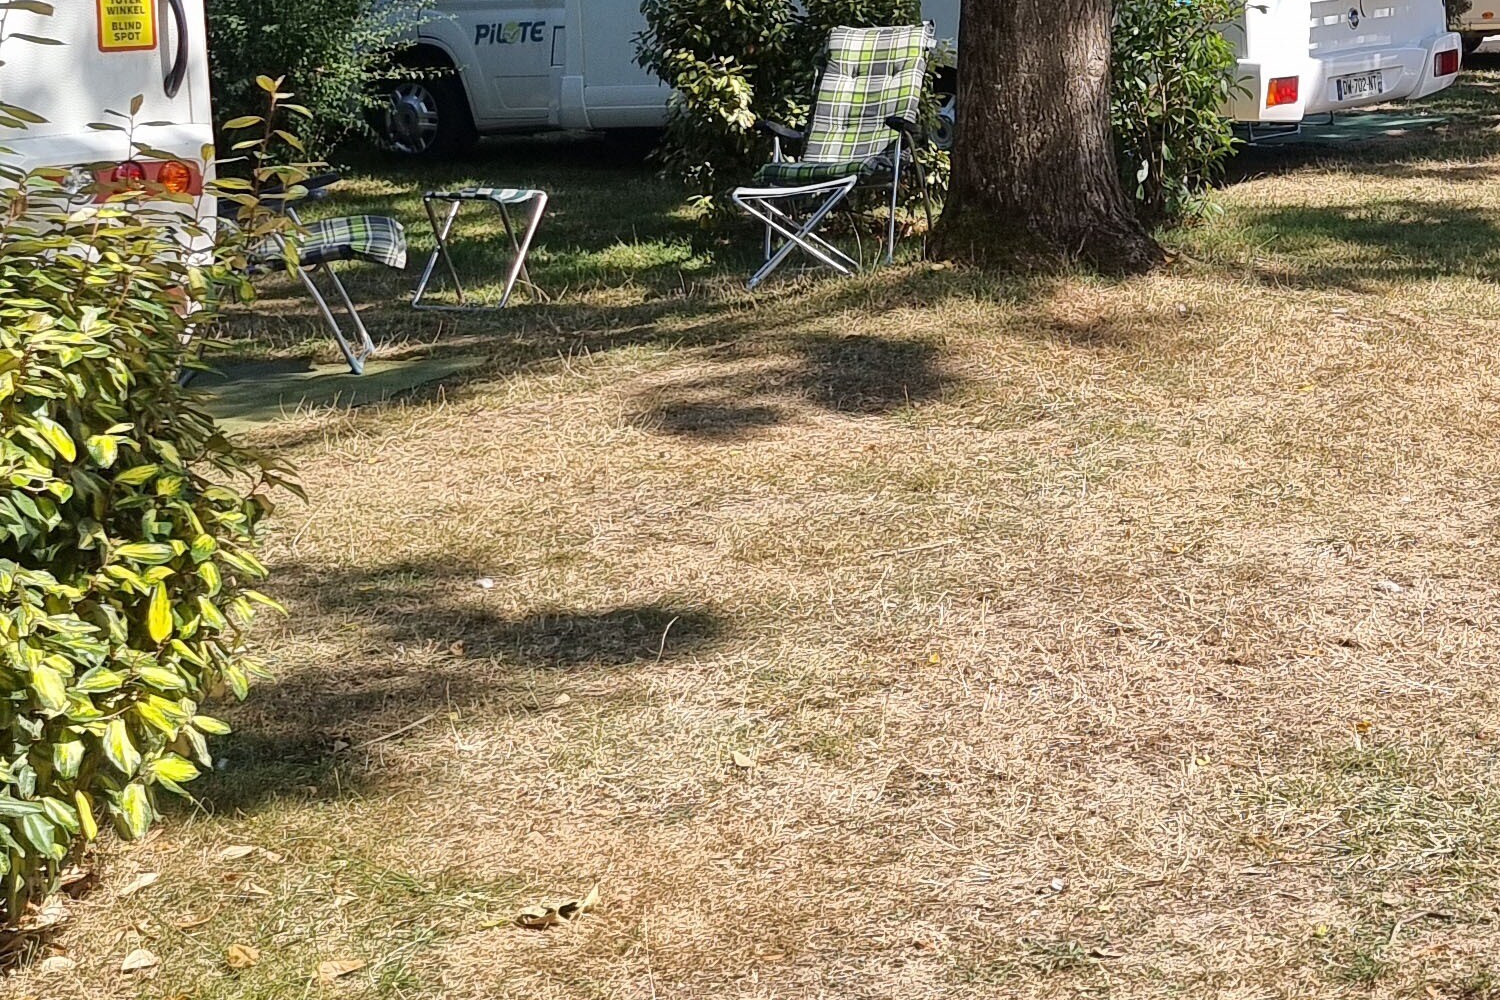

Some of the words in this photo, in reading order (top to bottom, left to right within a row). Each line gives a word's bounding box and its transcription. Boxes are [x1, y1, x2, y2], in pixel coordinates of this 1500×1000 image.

[107, 5, 145, 15] WINKEL
[112, 21, 142, 31] BLIND
[113, 31, 141, 41] SPOT
